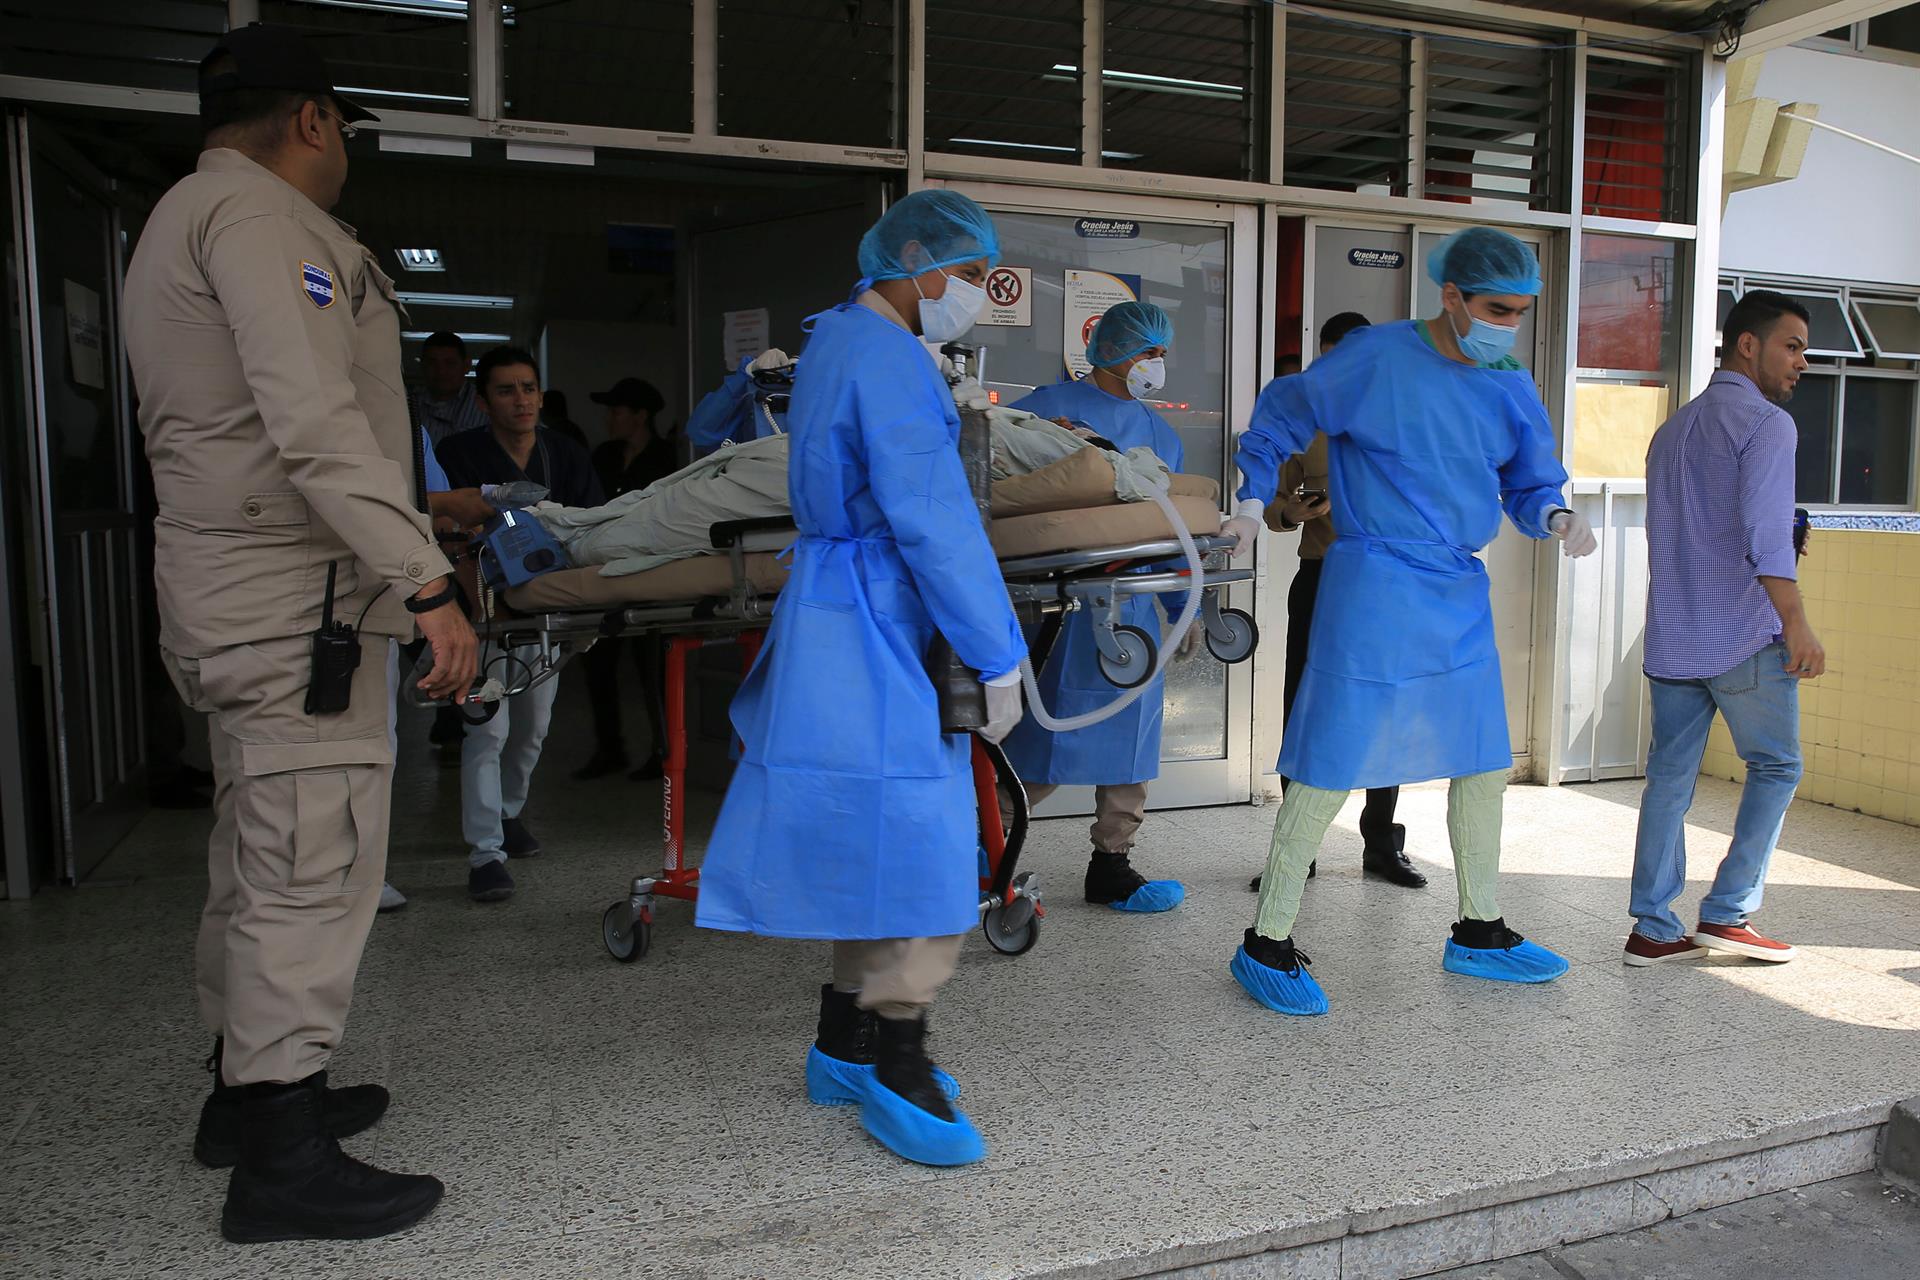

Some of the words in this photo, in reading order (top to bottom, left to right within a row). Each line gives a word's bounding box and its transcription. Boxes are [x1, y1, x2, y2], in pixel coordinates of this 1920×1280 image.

[1081, 220, 1111, 230] Gracias
[1111, 221, 1134, 231] Jesús
[1353, 250, 1380, 260] Gracias
[1380, 252, 1399, 261] Jesús
[303, 263, 331, 280] HONDURAS
